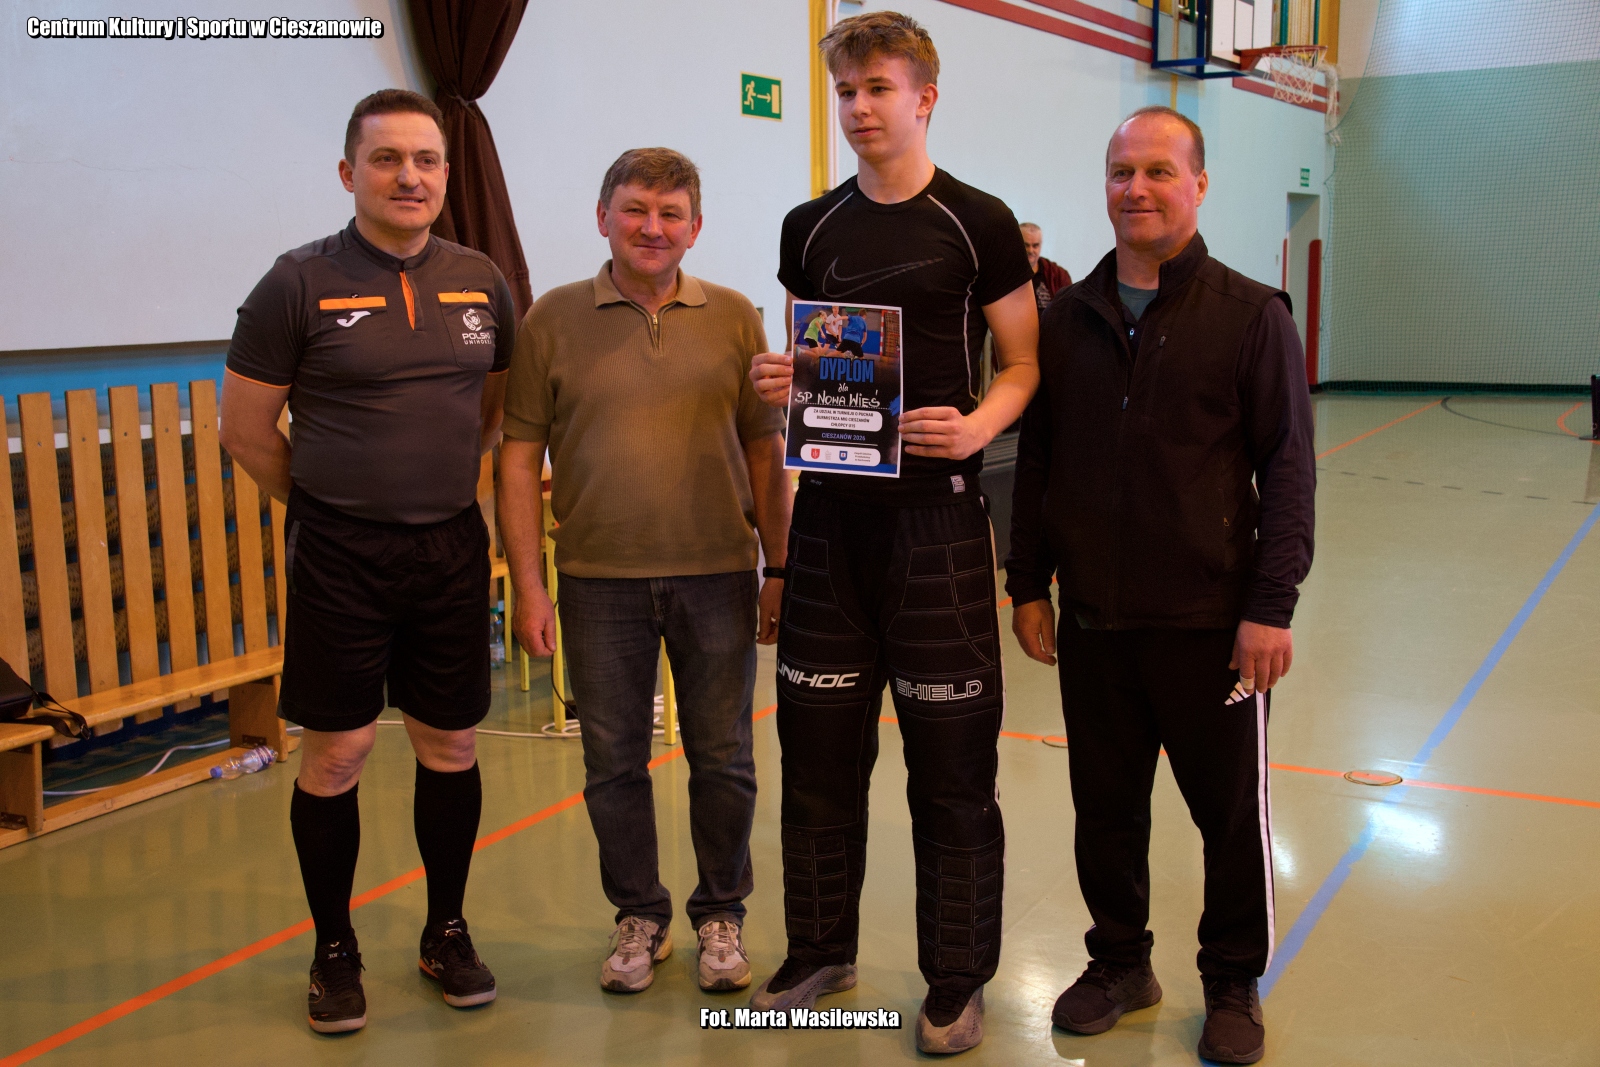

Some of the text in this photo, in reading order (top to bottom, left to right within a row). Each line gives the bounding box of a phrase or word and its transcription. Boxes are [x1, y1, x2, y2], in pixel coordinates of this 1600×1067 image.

[819, 357, 875, 383] DYPLOM
[795, 391, 813, 403] SP
[838, 382, 849, 393] dla
[821, 432, 852, 440] CIESZANÓW
[777, 658, 860, 688] UNIHOC
[896, 676, 983, 702] SHIELD
